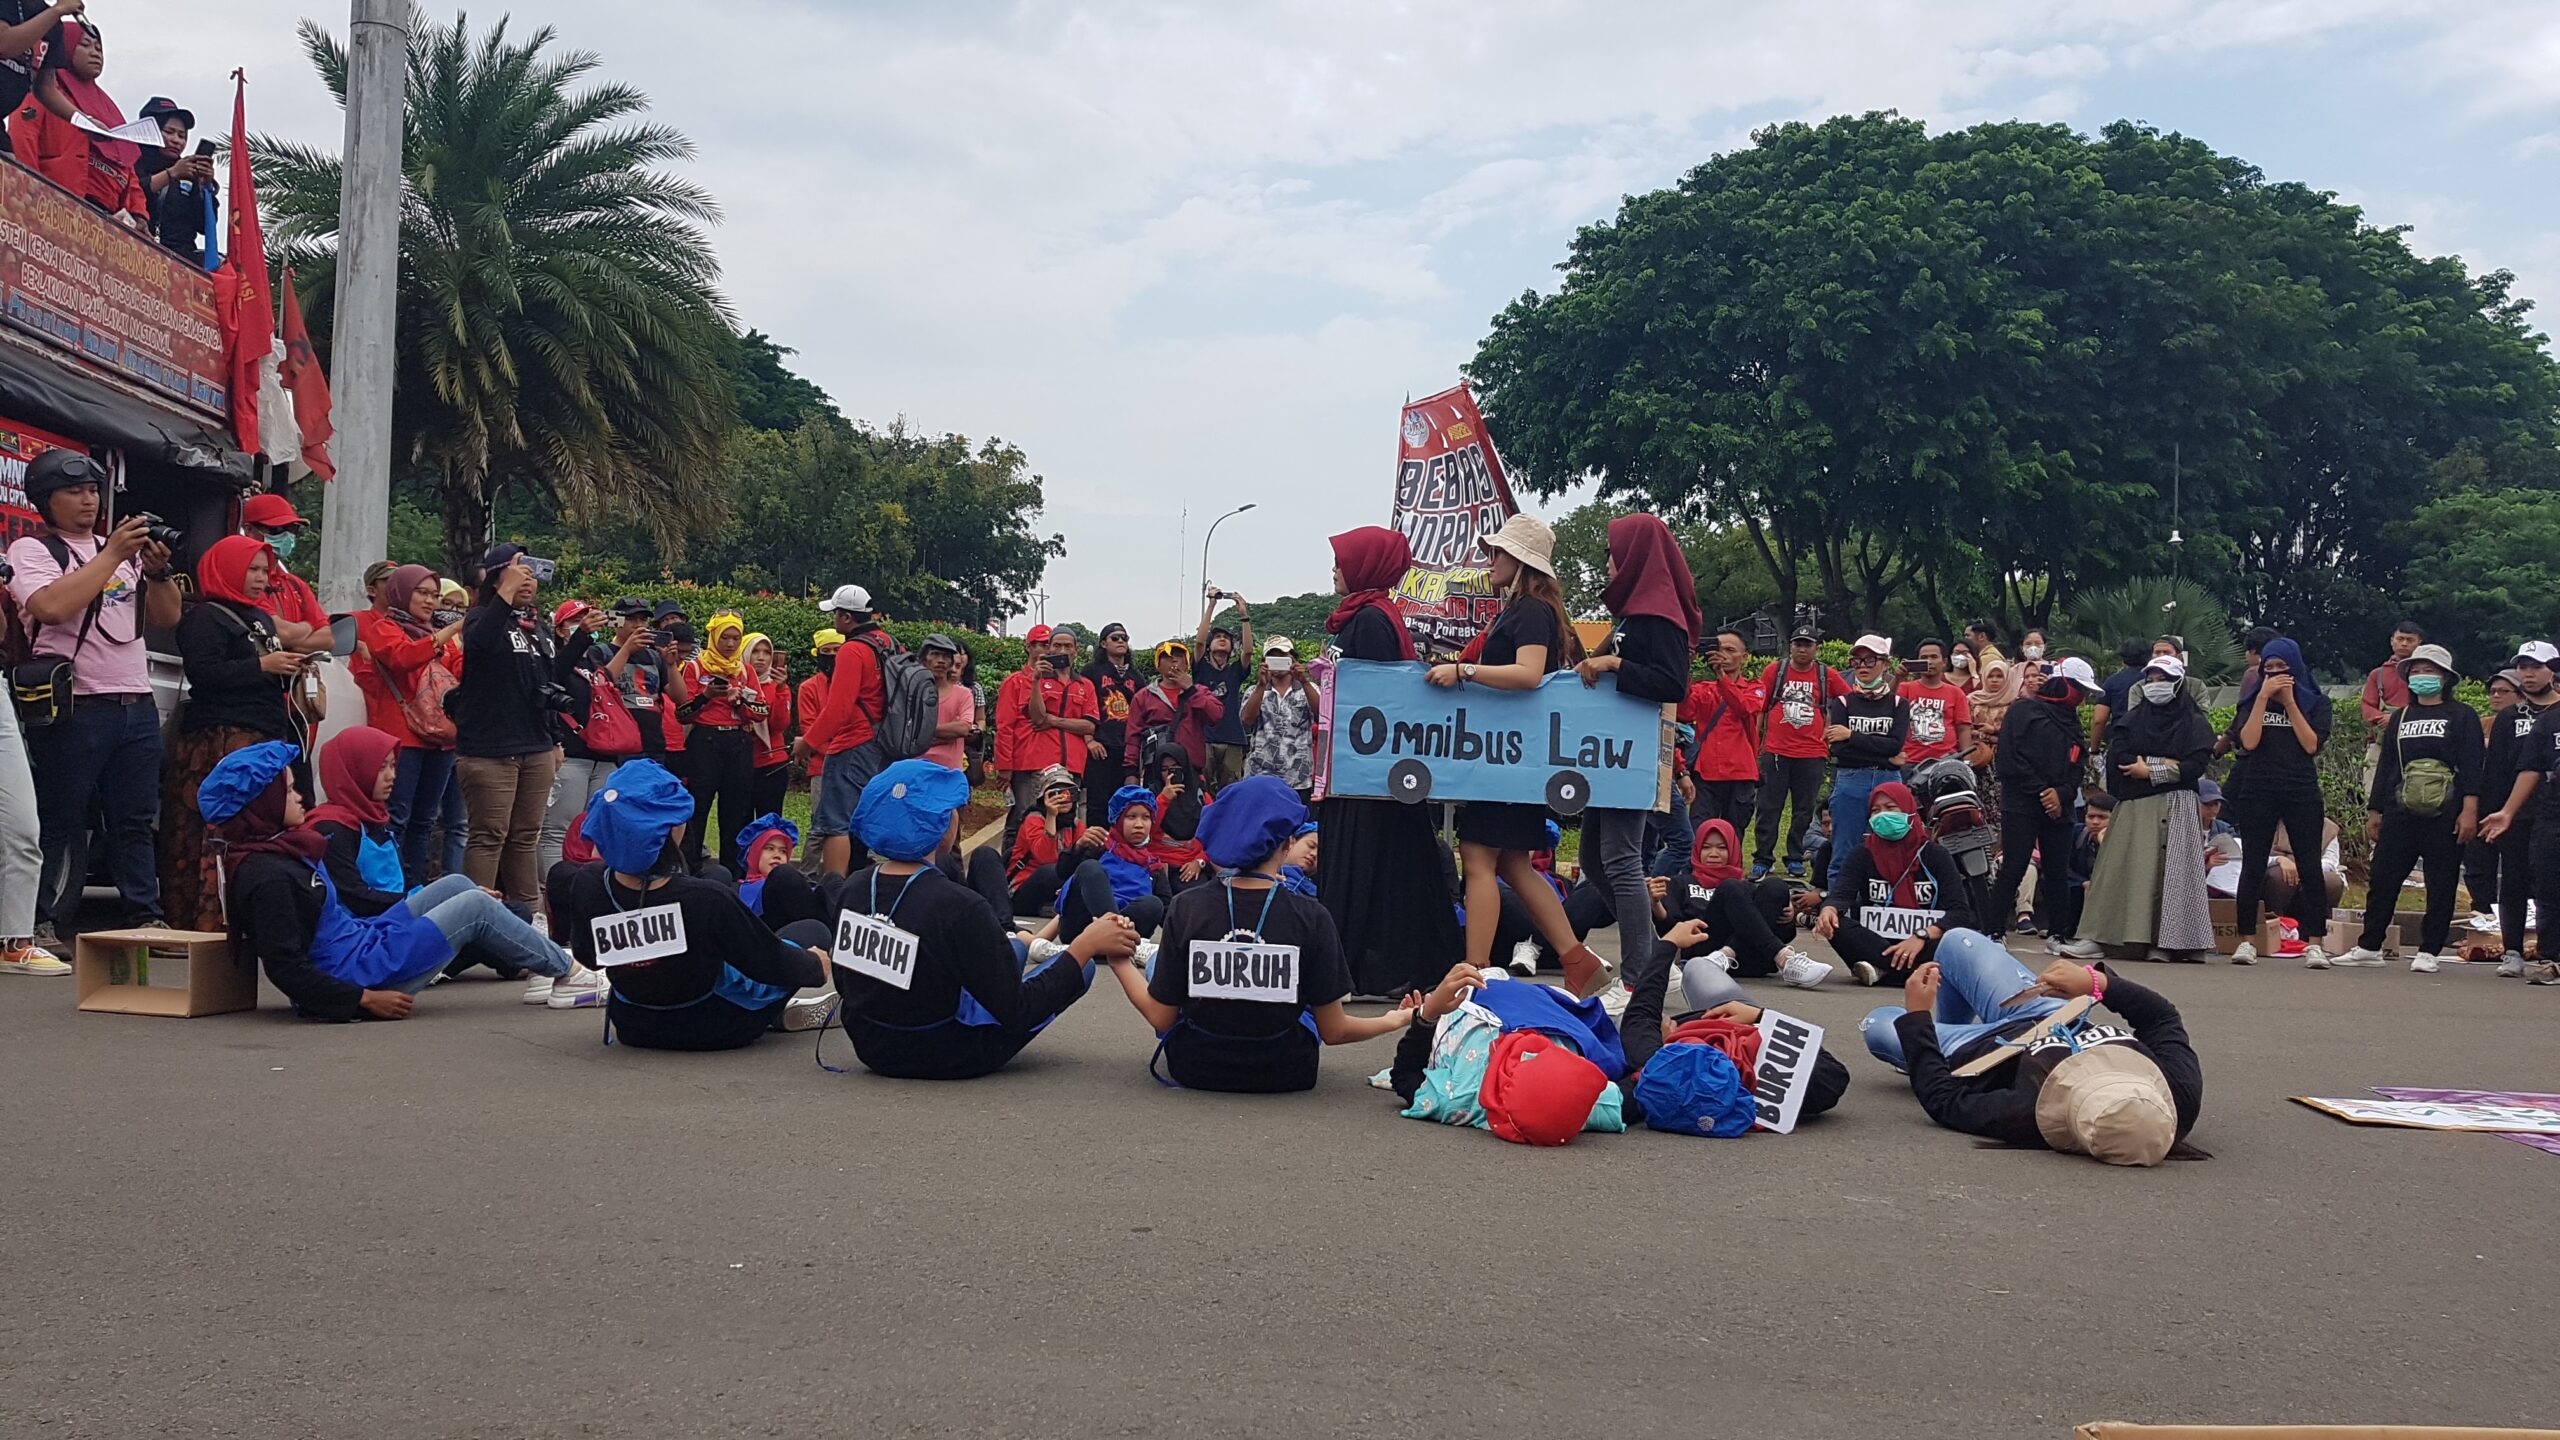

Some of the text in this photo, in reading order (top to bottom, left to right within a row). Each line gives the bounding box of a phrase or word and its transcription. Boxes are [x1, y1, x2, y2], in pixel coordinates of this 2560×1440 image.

[36, 194, 73, 237] CABUT
[76, 214, 89, 247] PP
[107, 234, 142, 277] TAHUN
[1788, 680, 1813, 692] KPBI
[1918, 697, 1944, 708] KPBI
[1349, 706, 1633, 769] Omnibus Law
[595, 912, 677, 954] BURUH
[838, 920, 910, 974] BURUH
[1193, 951, 1291, 989] BURUH
[1755, 1019, 1810, 1125] BURUH
